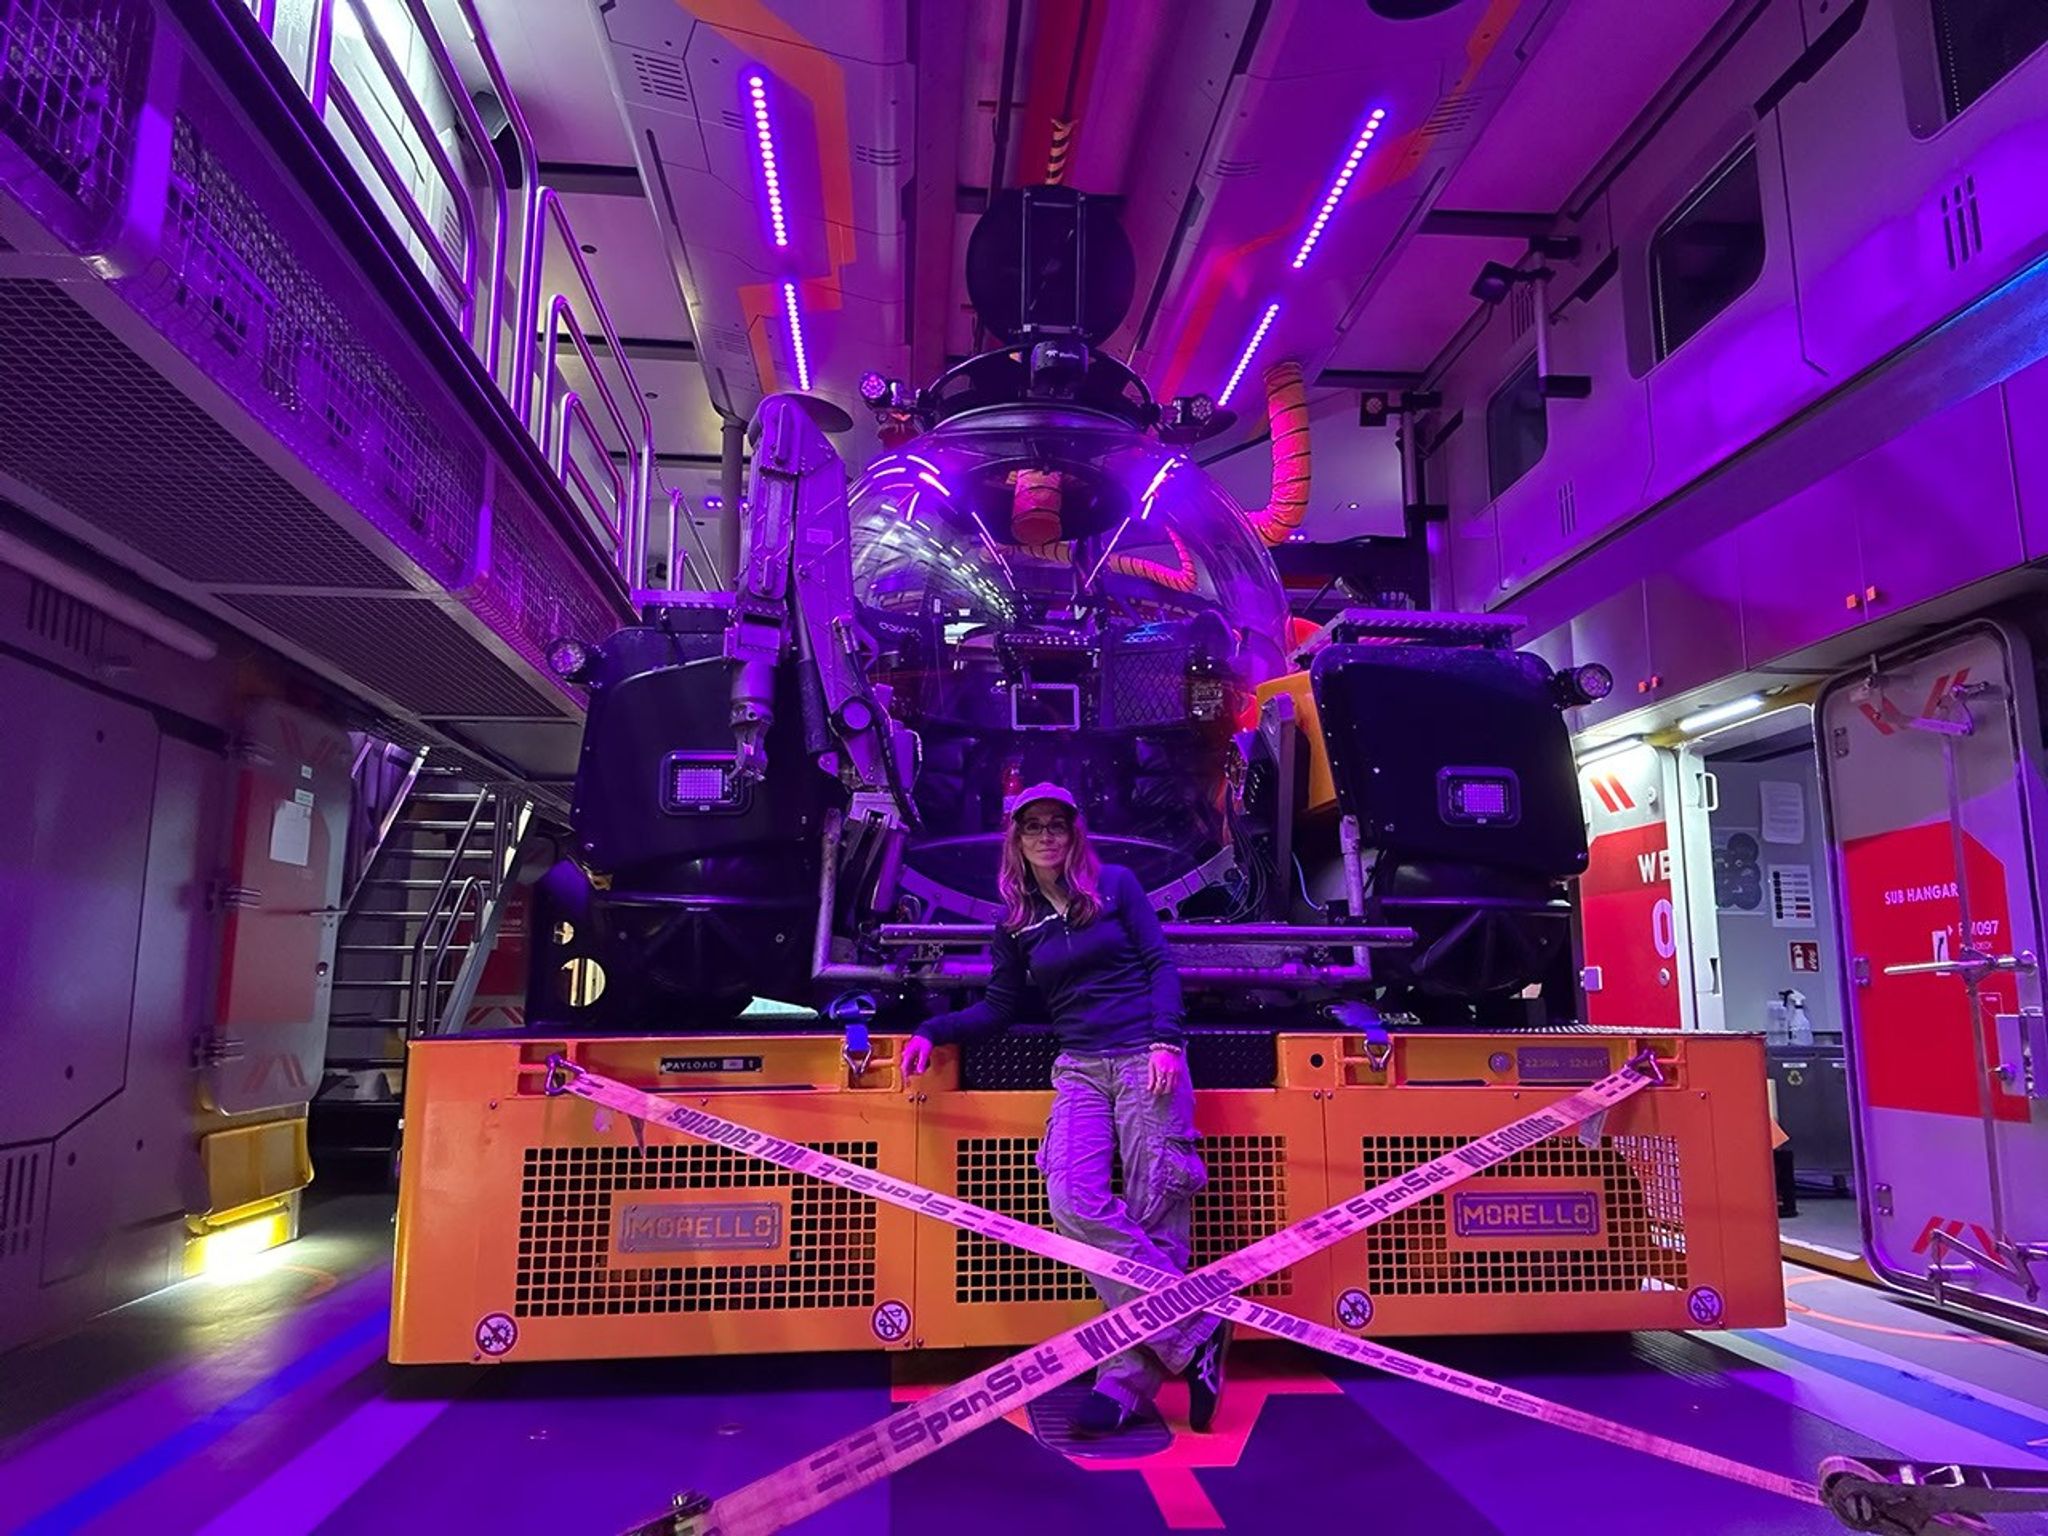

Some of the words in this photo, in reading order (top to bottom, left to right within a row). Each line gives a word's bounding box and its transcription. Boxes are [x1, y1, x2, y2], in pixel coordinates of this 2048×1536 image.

[1884, 888, 1905, 905] SUB
[1906, 882, 1960, 902] HANGAR
[665, 1061, 718, 1071] PAYLOAD
[754, 1137, 809, 1168] WLL
[1345, 1161, 1455, 1221] SpanSet
[1453, 1139, 1499, 1169] WLL
[1490, 1113, 1566, 1157] 5000lbs
[812, 1161, 957, 1217] SpanSet
[630, 1214, 773, 1240] MORELLO
[1462, 1202, 1591, 1226] MORELLO
[1245, 1303, 1311, 1337] WLL
[887, 1346, 1065, 1452] SpanSet
[1074, 1313, 1143, 1362] WLL
[1129, 1268, 1244, 1331] 5000lbs
[1330, 1339, 1543, 1415] SpanSet
